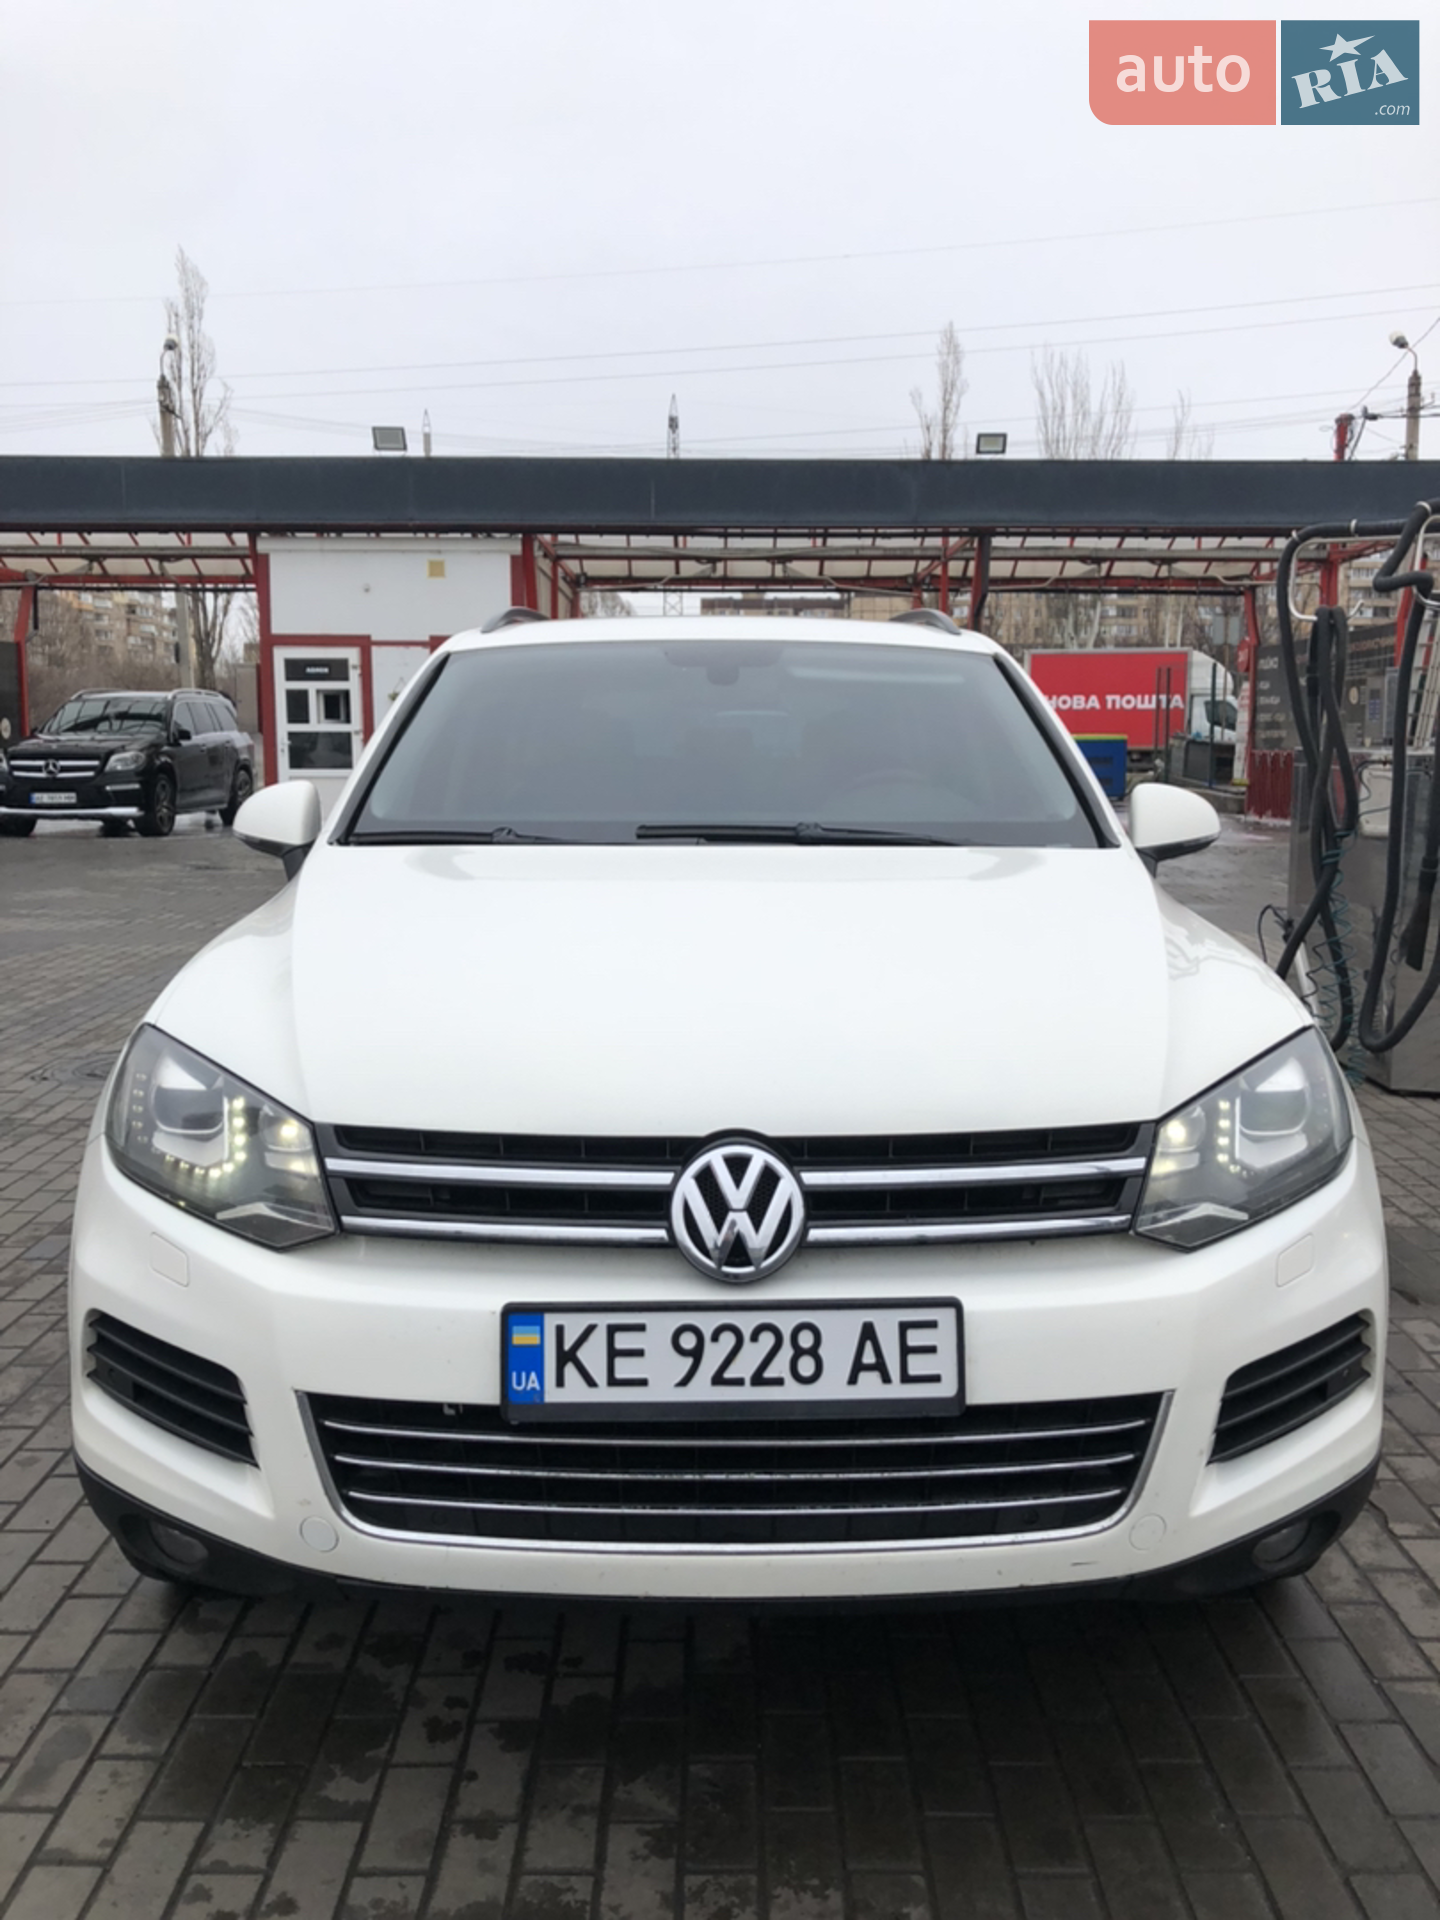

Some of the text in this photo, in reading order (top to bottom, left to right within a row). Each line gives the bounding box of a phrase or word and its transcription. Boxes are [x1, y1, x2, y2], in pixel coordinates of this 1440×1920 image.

[1105, 694, 1185, 710] ПОШТА
[554, 1319, 942, 1389] KE 9228 AE
[511, 1371, 541, 1392] UA
